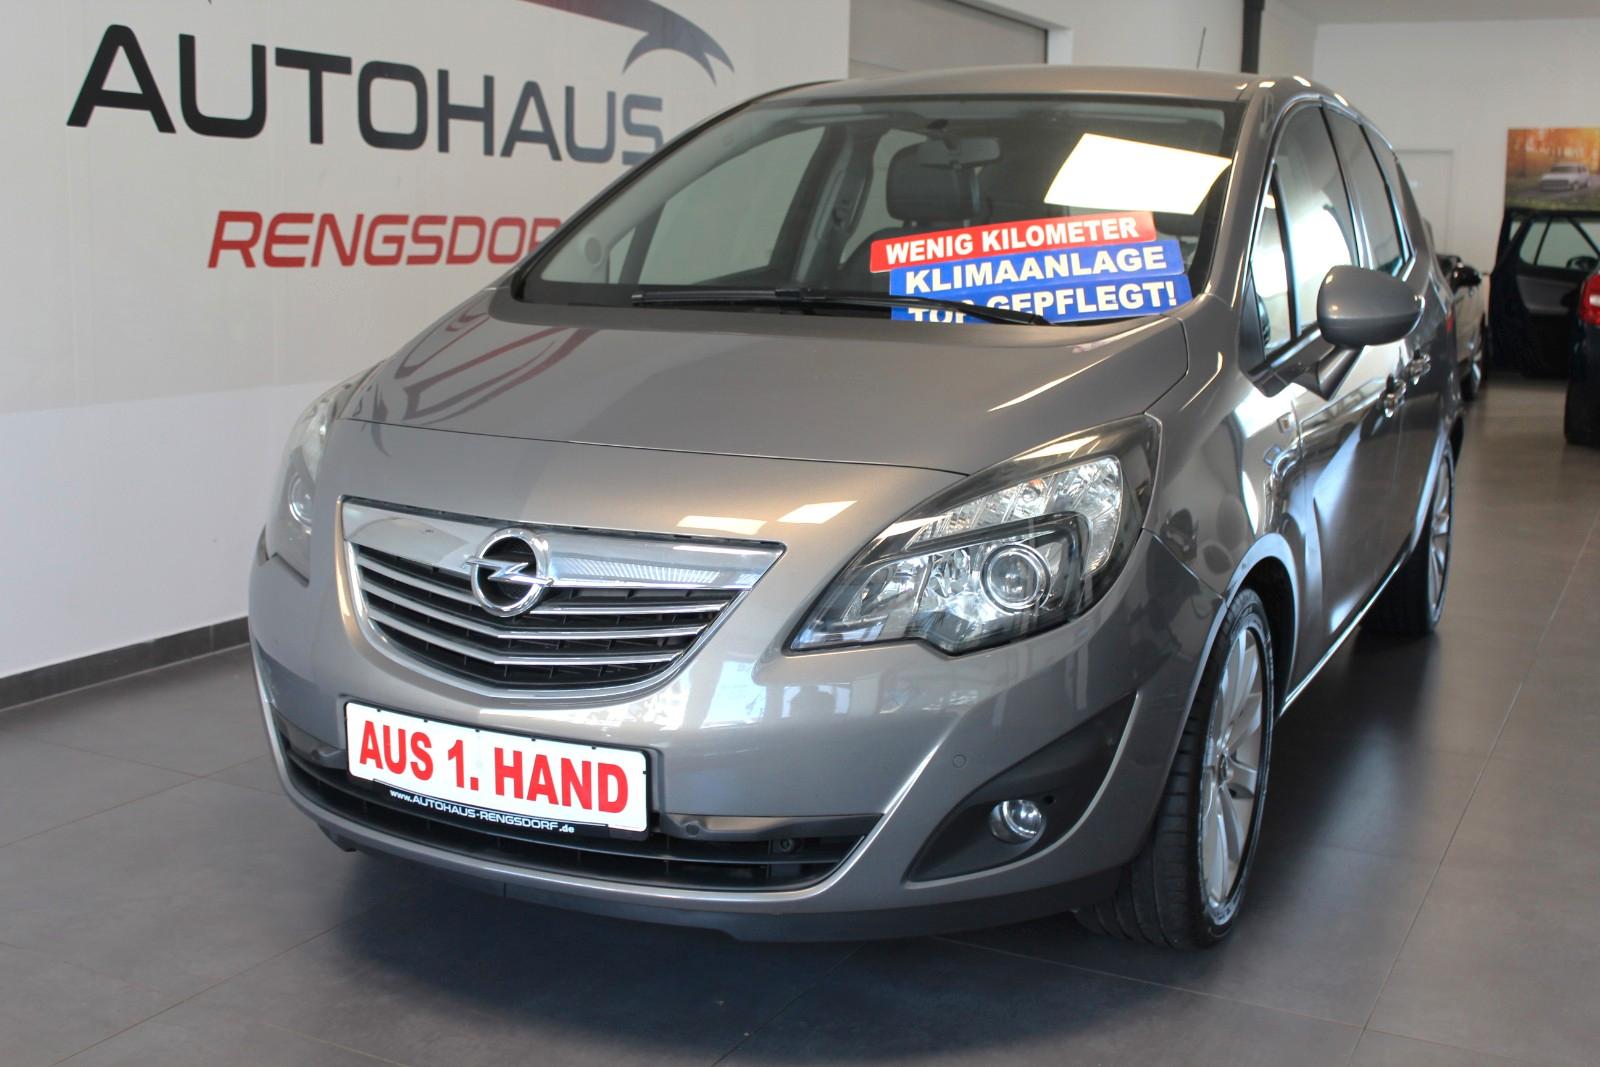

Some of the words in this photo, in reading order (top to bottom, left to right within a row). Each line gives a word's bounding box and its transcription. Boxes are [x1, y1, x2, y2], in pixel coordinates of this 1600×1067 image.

[66, 24, 663, 166] AUTOHAUS
[886, 235, 973, 265] WENIG
[982, 217, 1139, 253] KILOMETER
[905, 246, 1167, 294] KLIMAANLAGE
[359, 720, 434, 781] AUS
[447, 739, 480, 791] 1.
[494, 747, 629, 813] HAND
